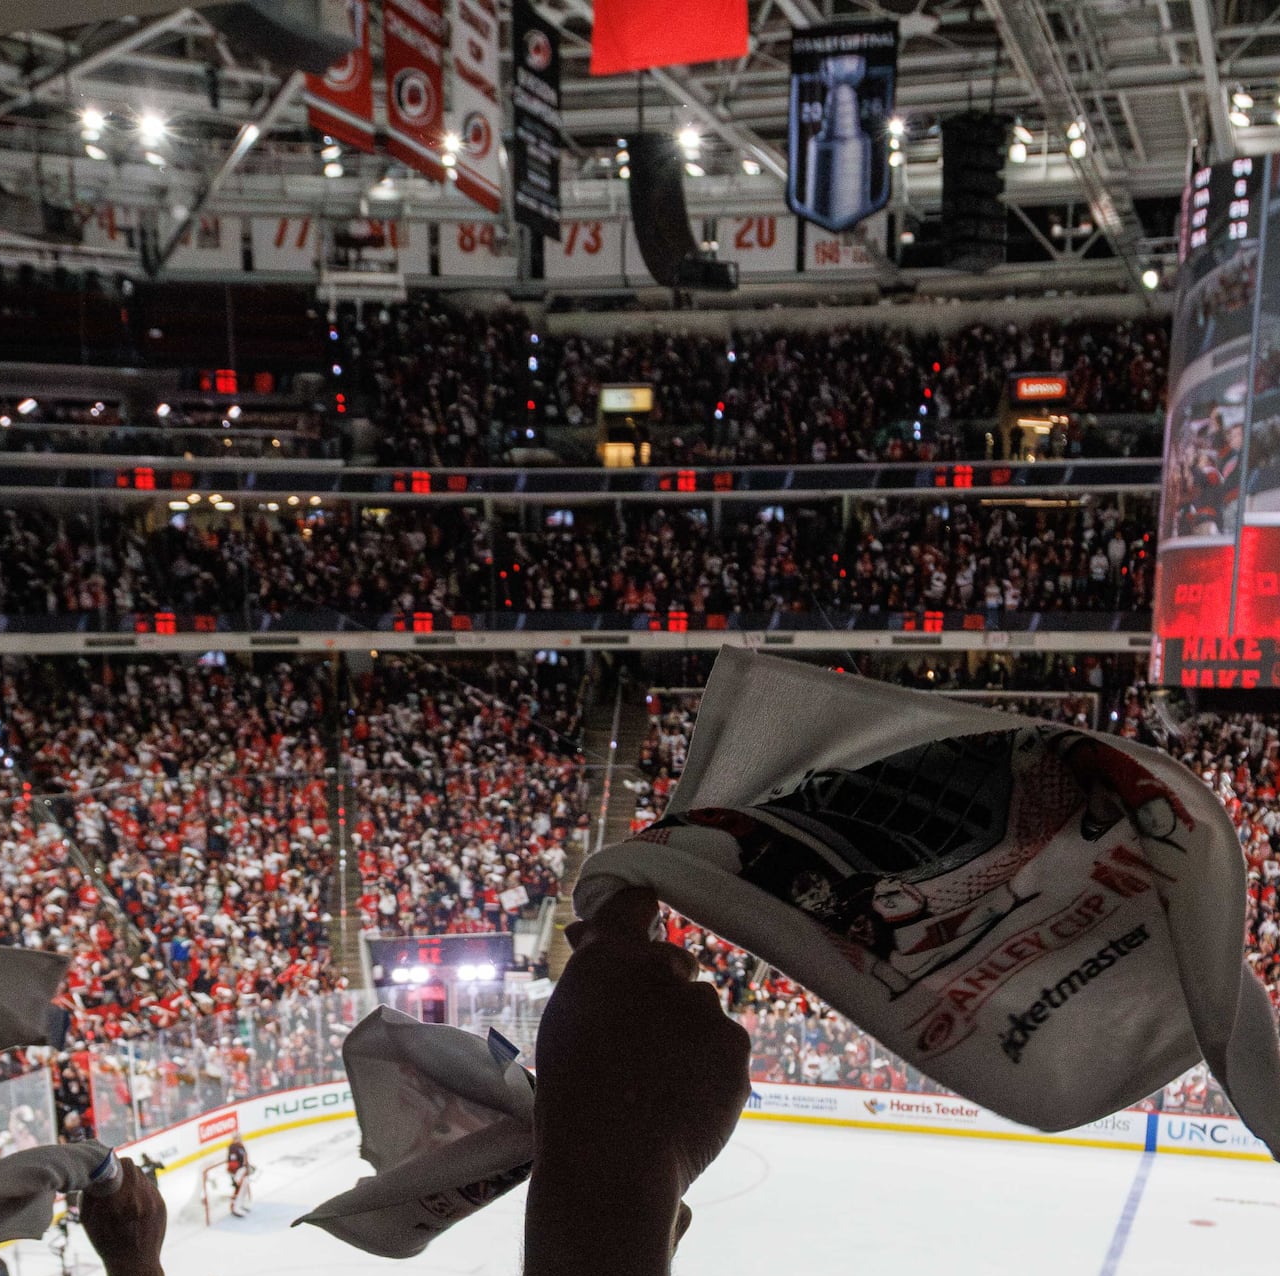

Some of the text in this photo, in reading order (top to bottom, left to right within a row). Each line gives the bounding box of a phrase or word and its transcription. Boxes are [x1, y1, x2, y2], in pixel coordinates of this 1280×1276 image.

[950, 894, 1113, 1011] ANLEY CUP
[889, 1099, 932, 1114] Harris
[935, 1103, 980, 1118] Teeter
[200, 1117, 236, 1140] Lenovo
[1167, 1120, 1229, 1144] UNC
